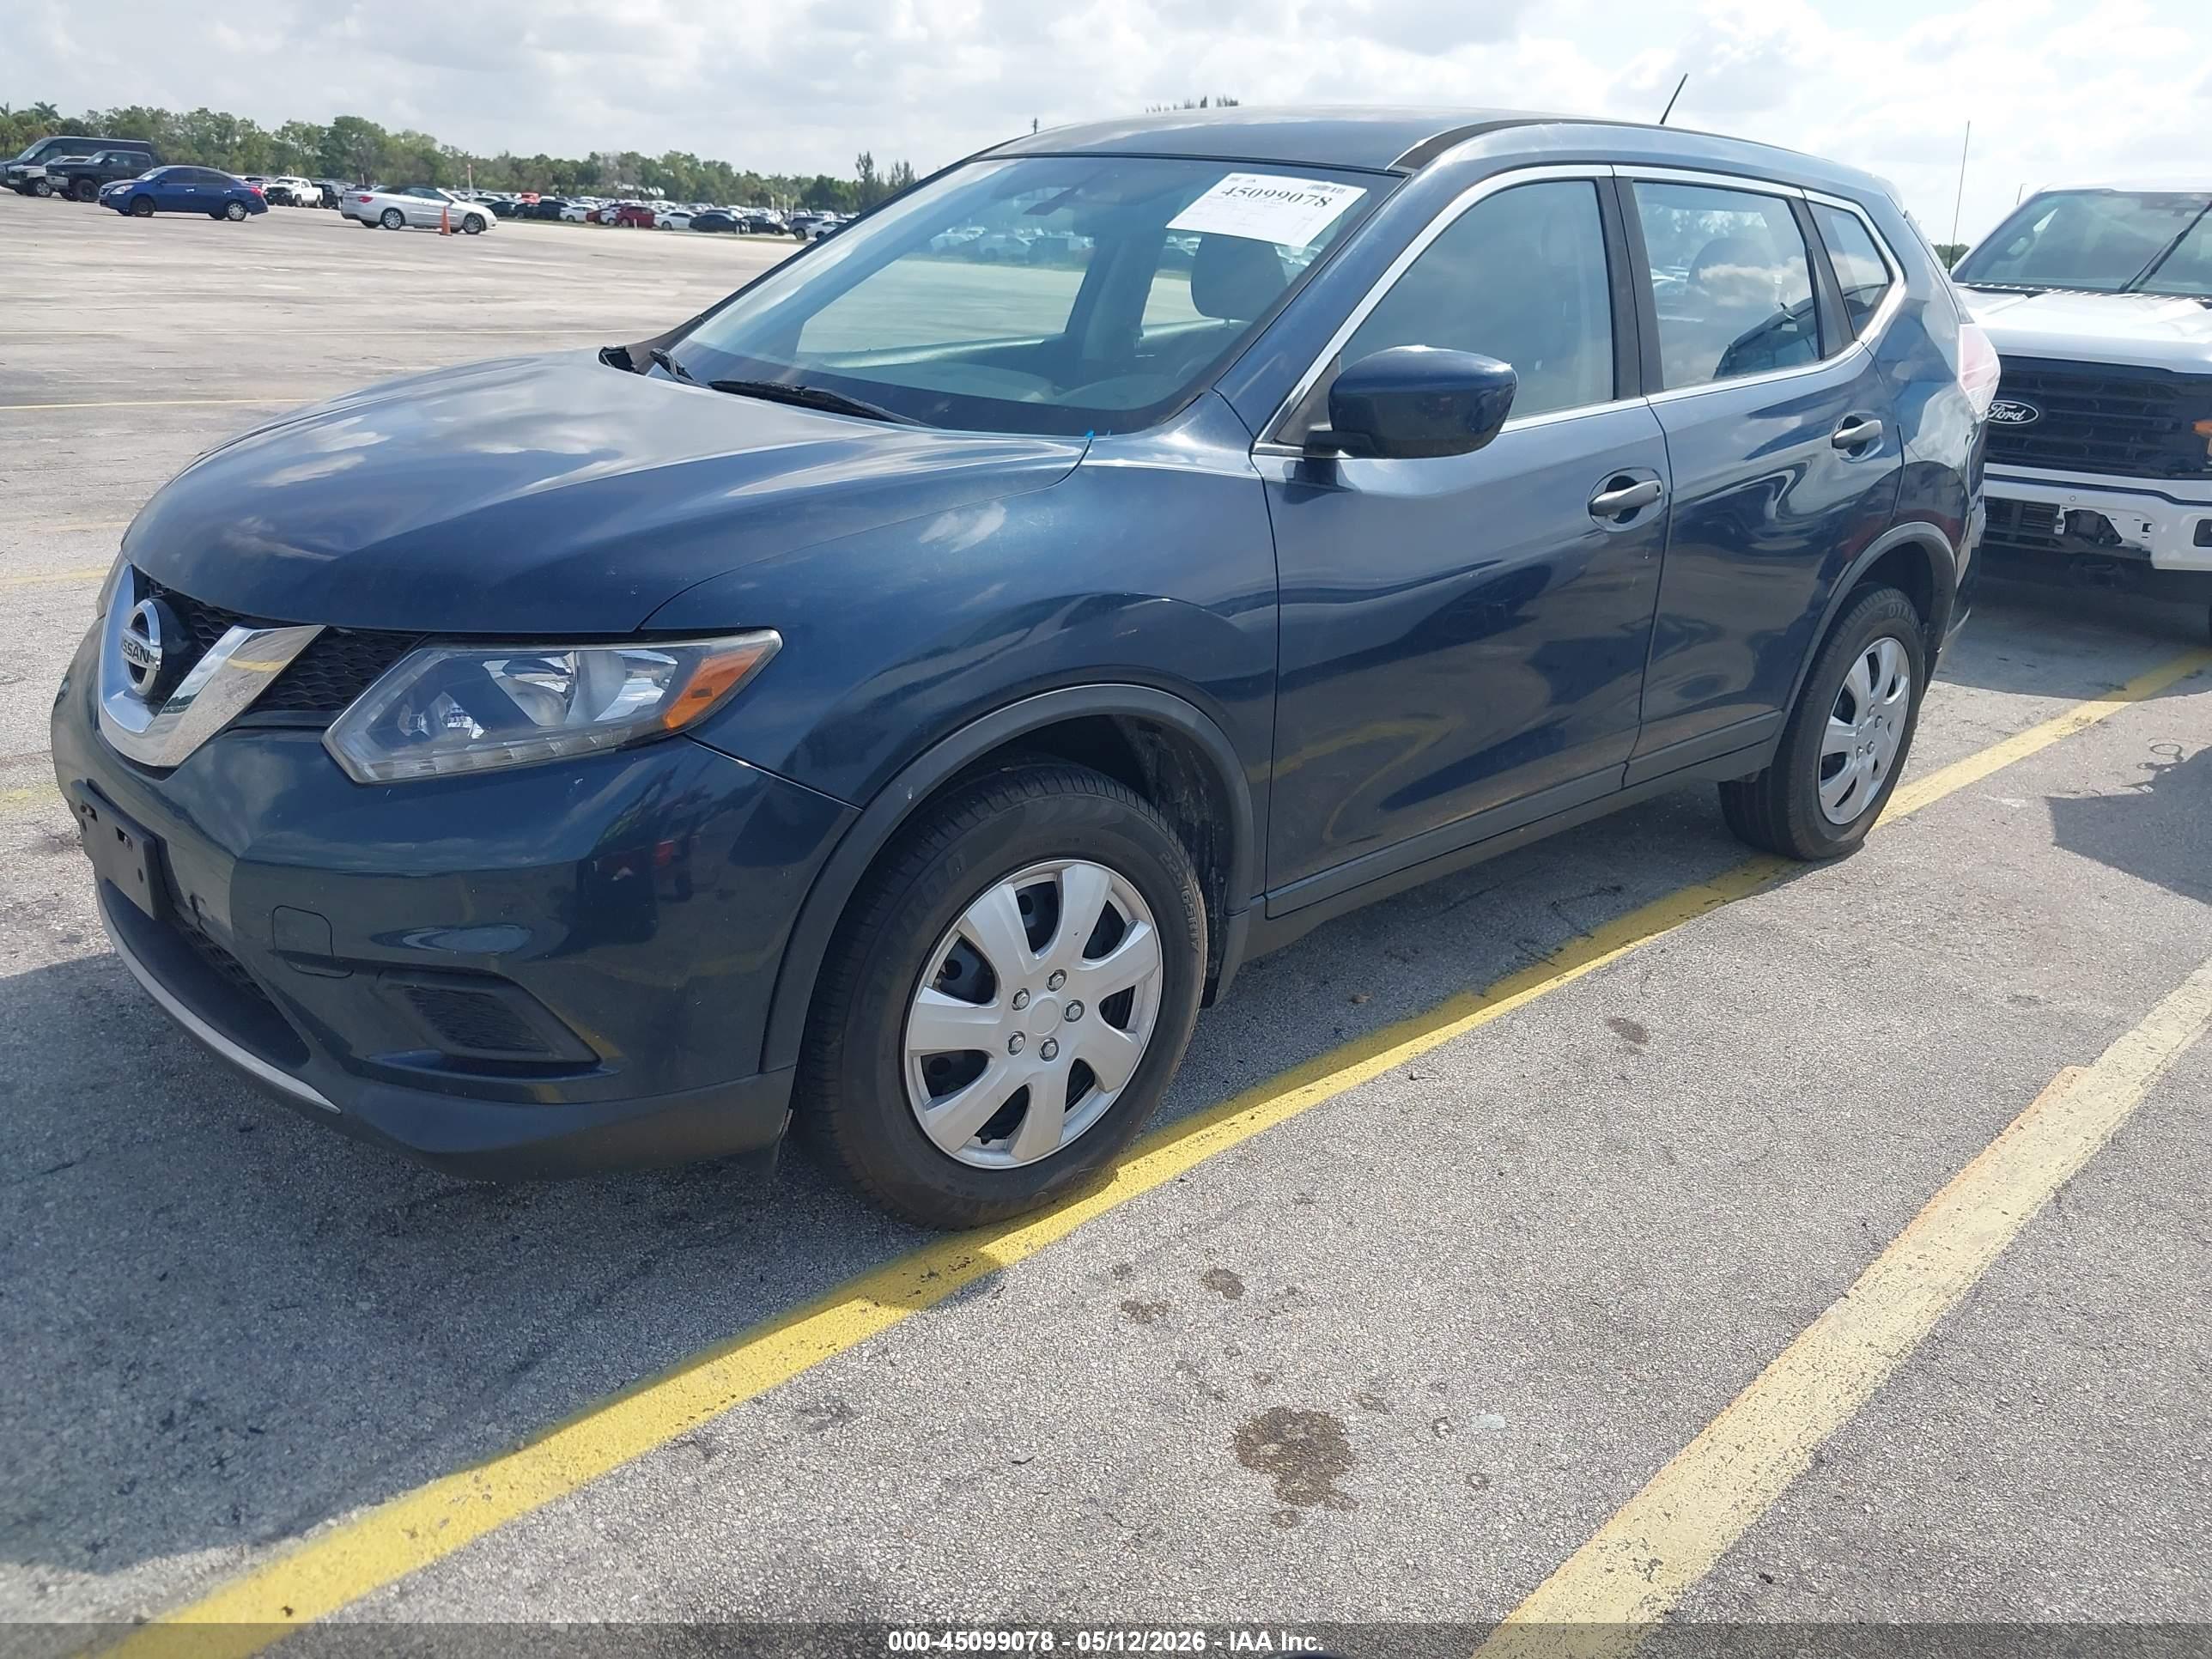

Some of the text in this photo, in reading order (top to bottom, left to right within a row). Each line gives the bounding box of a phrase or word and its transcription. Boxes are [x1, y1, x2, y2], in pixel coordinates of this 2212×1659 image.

[1221, 185, 1334, 208] 45099078
[1988, 403, 2027, 422] Ford
[122, 638, 151, 664] SSAN
